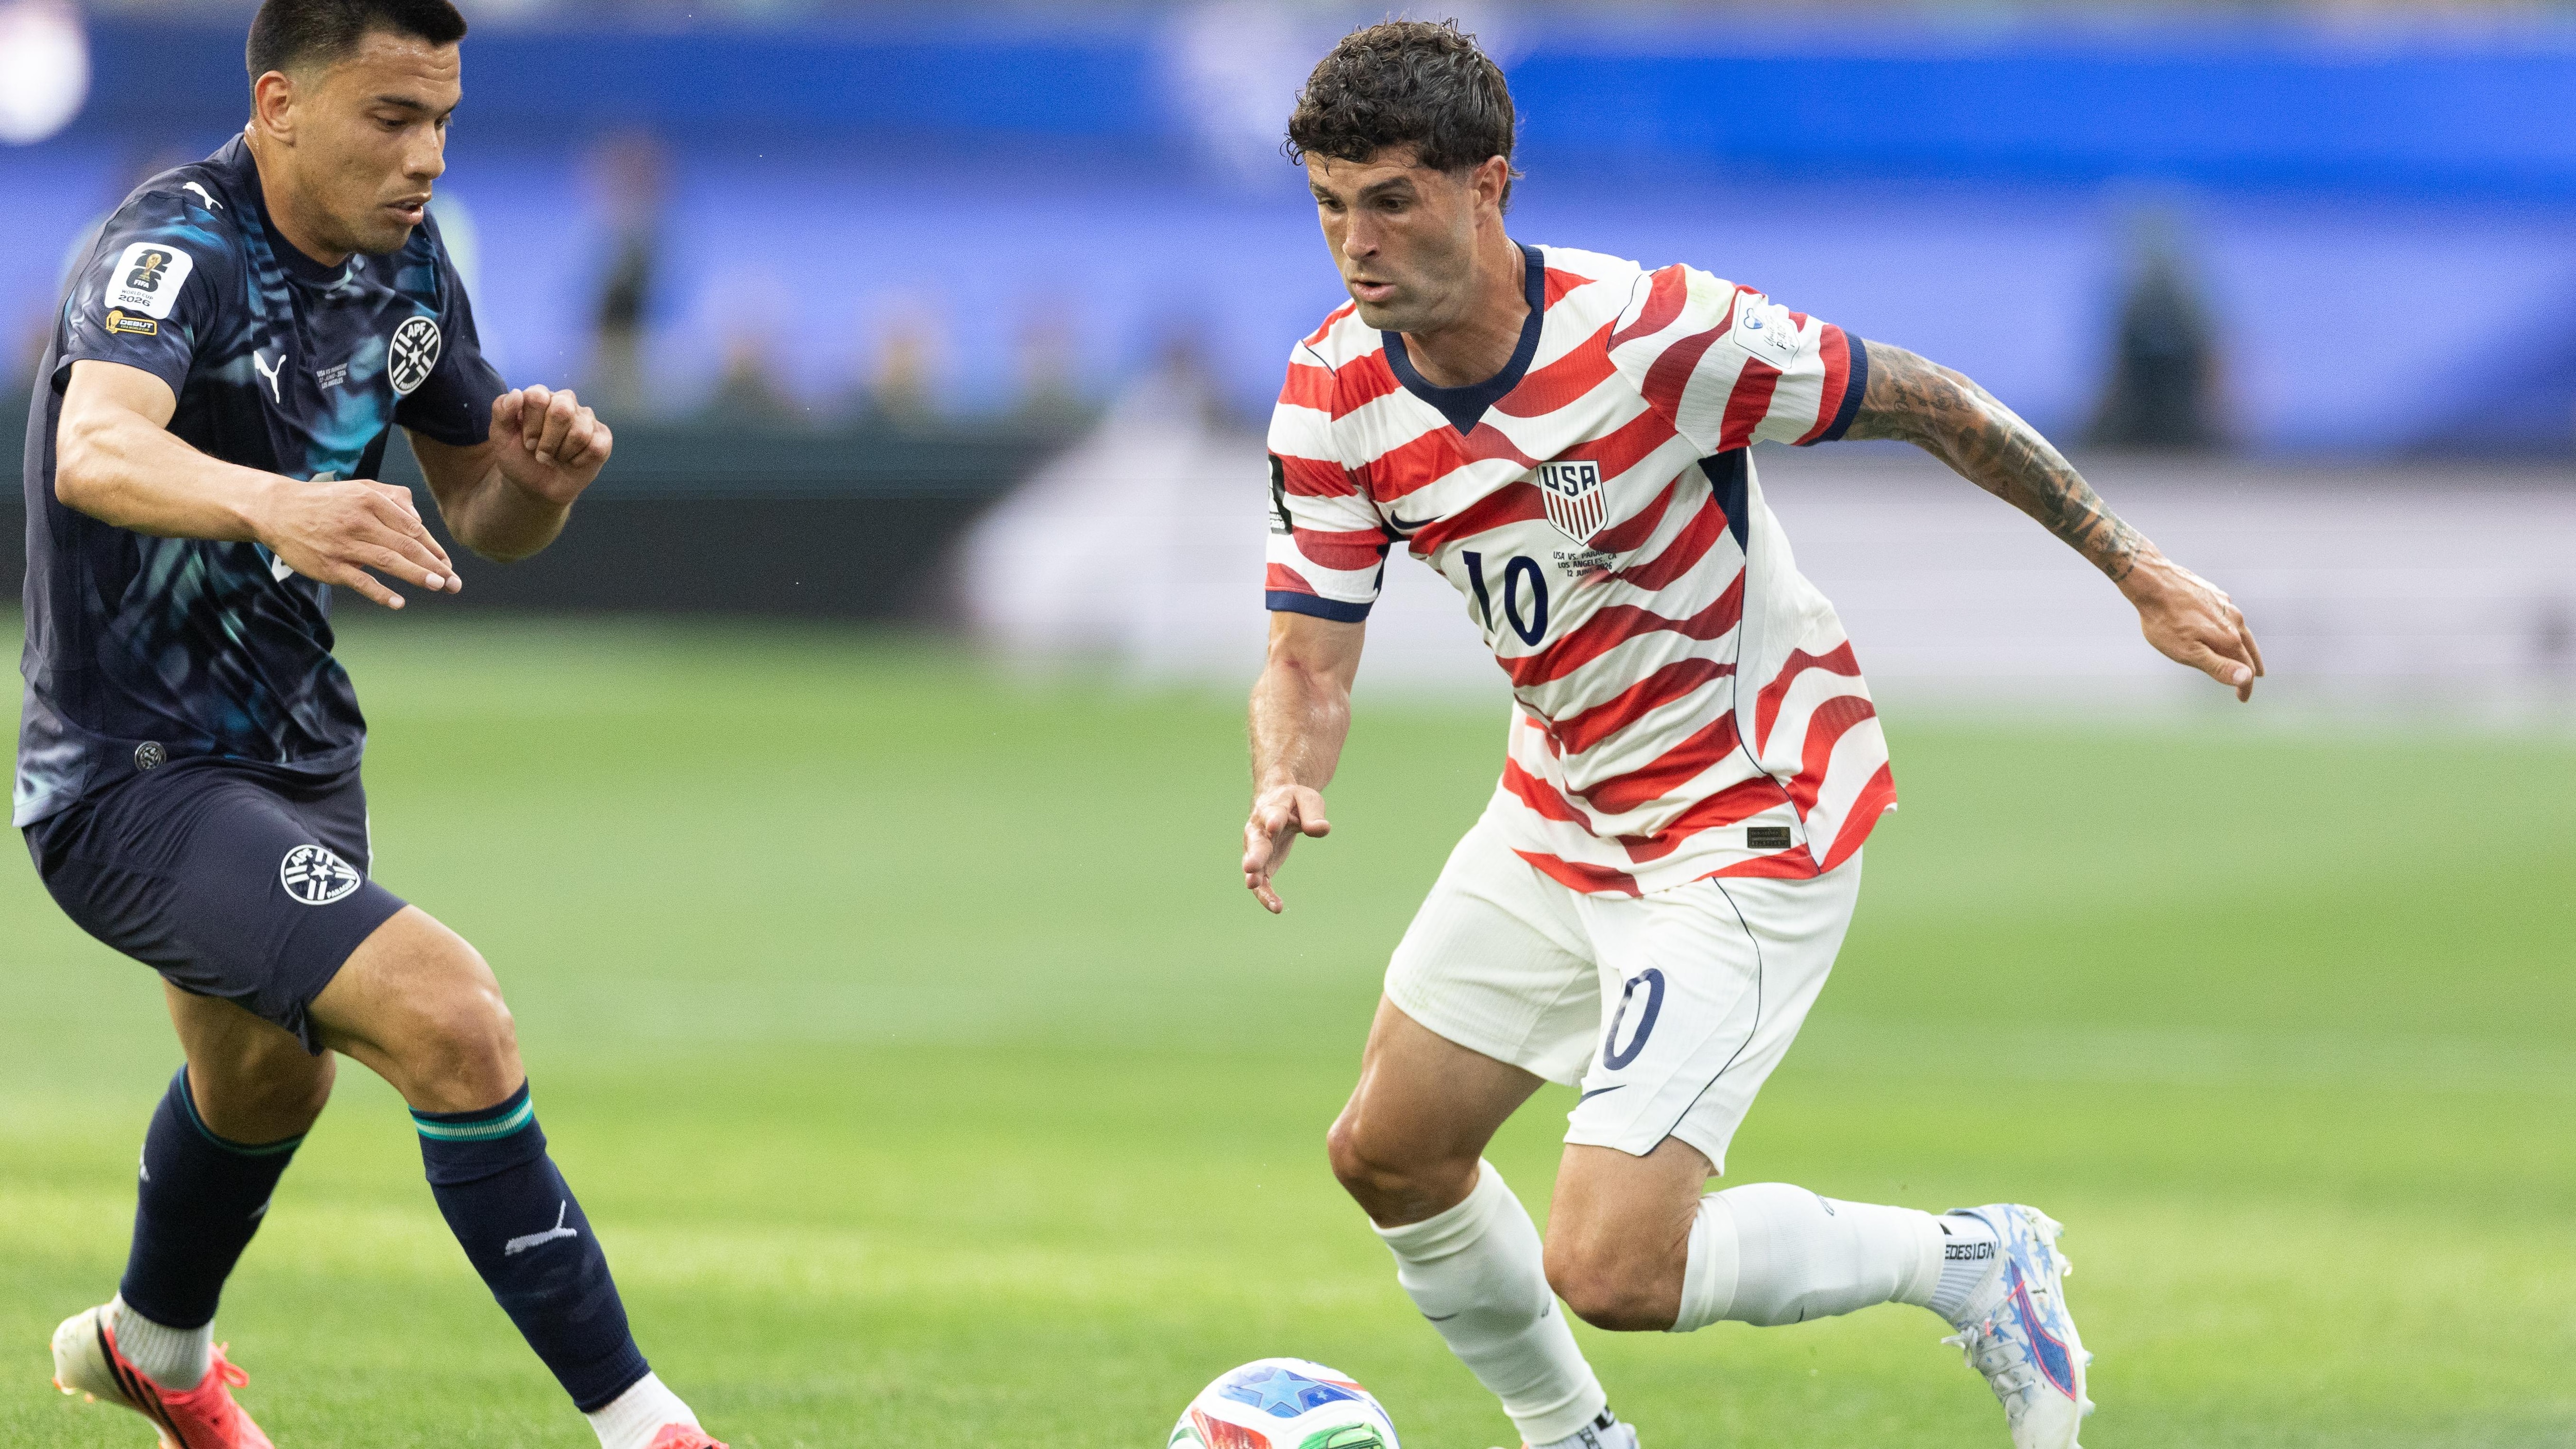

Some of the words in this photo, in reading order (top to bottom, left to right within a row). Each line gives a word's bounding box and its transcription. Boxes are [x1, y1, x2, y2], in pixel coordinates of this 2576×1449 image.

[134, 279, 149, 289] FIFA
[118, 295, 151, 307] 2026
[120, 319, 153, 328] DEBUT
[407, 322, 426, 338] APF
[316, 369, 326, 378] USA
[328, 377, 344, 386] ANGELES
[1541, 465, 1597, 497] USA
[1553, 551, 1565, 561] USA
[1581, 548, 1608, 559] PARAG
[1577, 567, 1593, 577] JUN
[1462, 550, 1548, 647] 10
[291, 848, 314, 867] APF
